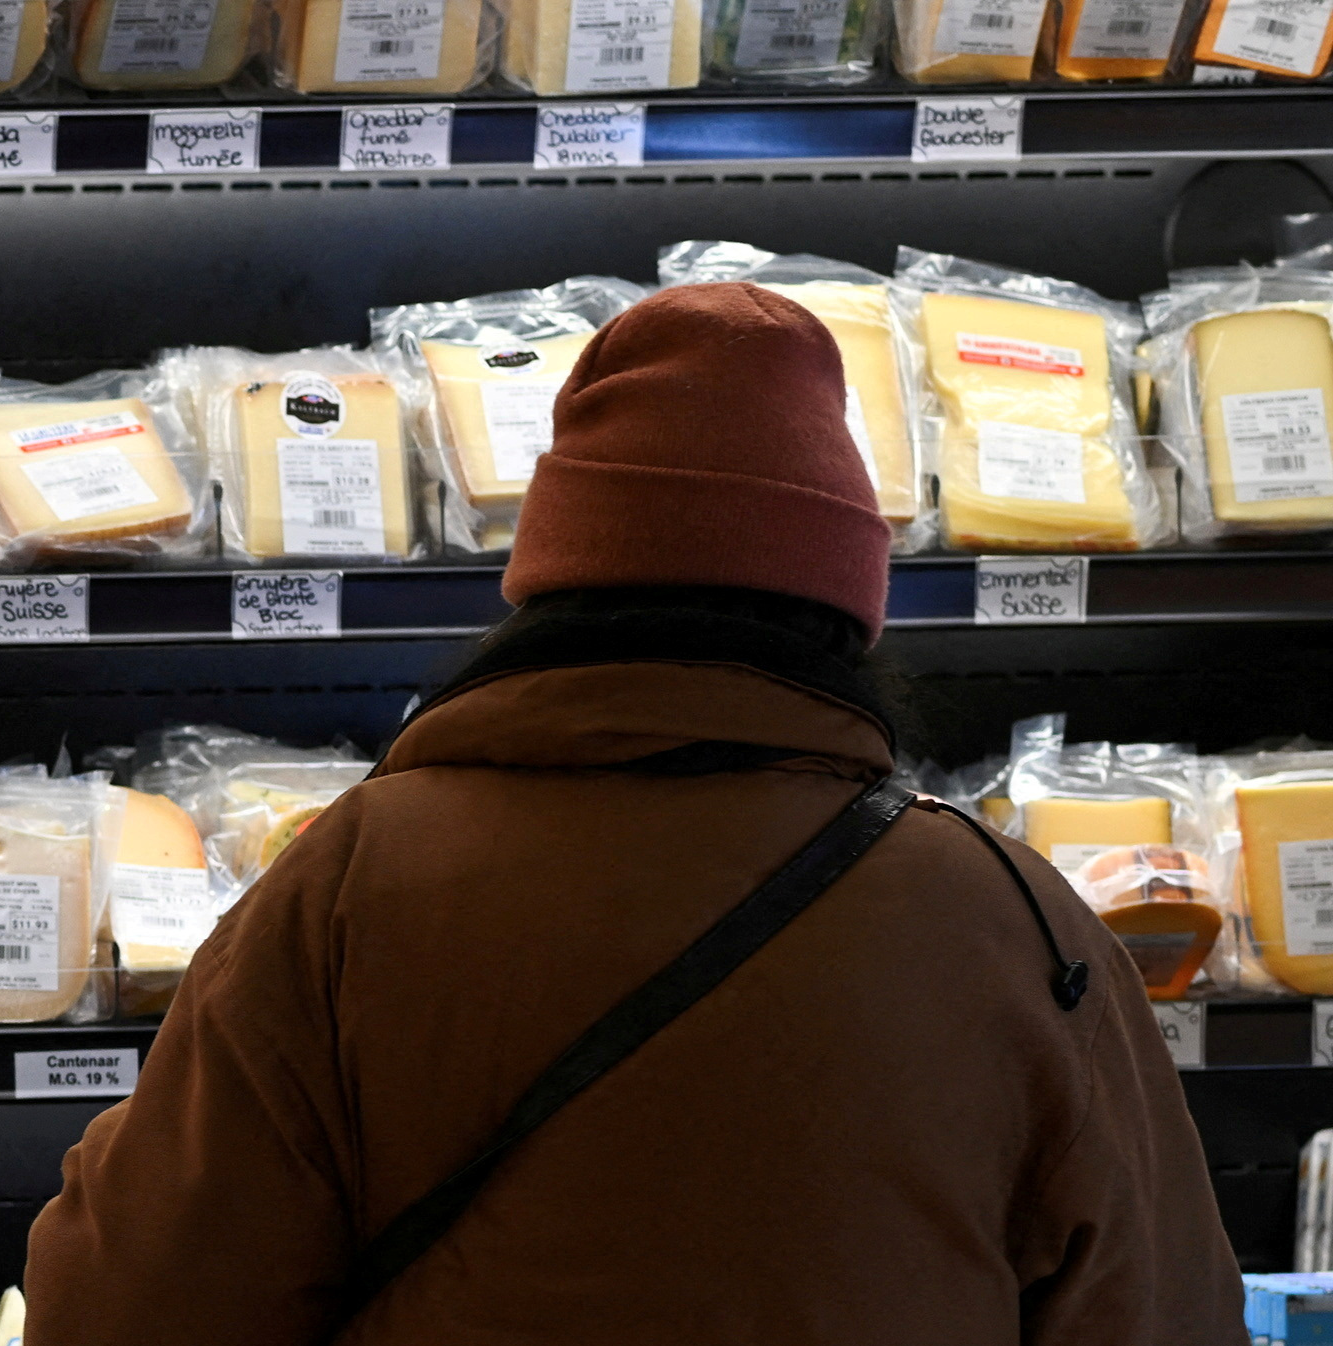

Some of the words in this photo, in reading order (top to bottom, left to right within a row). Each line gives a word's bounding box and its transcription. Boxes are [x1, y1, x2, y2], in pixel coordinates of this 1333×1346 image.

[921, 105, 987, 126] Double
[548, 126, 632, 146] Dubliner
[234, 576, 311, 599] Gruyère
[1, 600, 69, 622] Suisse
[239, 593, 261, 609] de
[1000, 592, 1069, 617] Suisse
[258, 607, 304, 624] Bloc
[46, 1056, 121, 1070] Cantenaar
[47, 1072, 81, 1086] M.G.
[84, 1072, 101, 1086] 19
[104, 1072, 120, 1084] %
